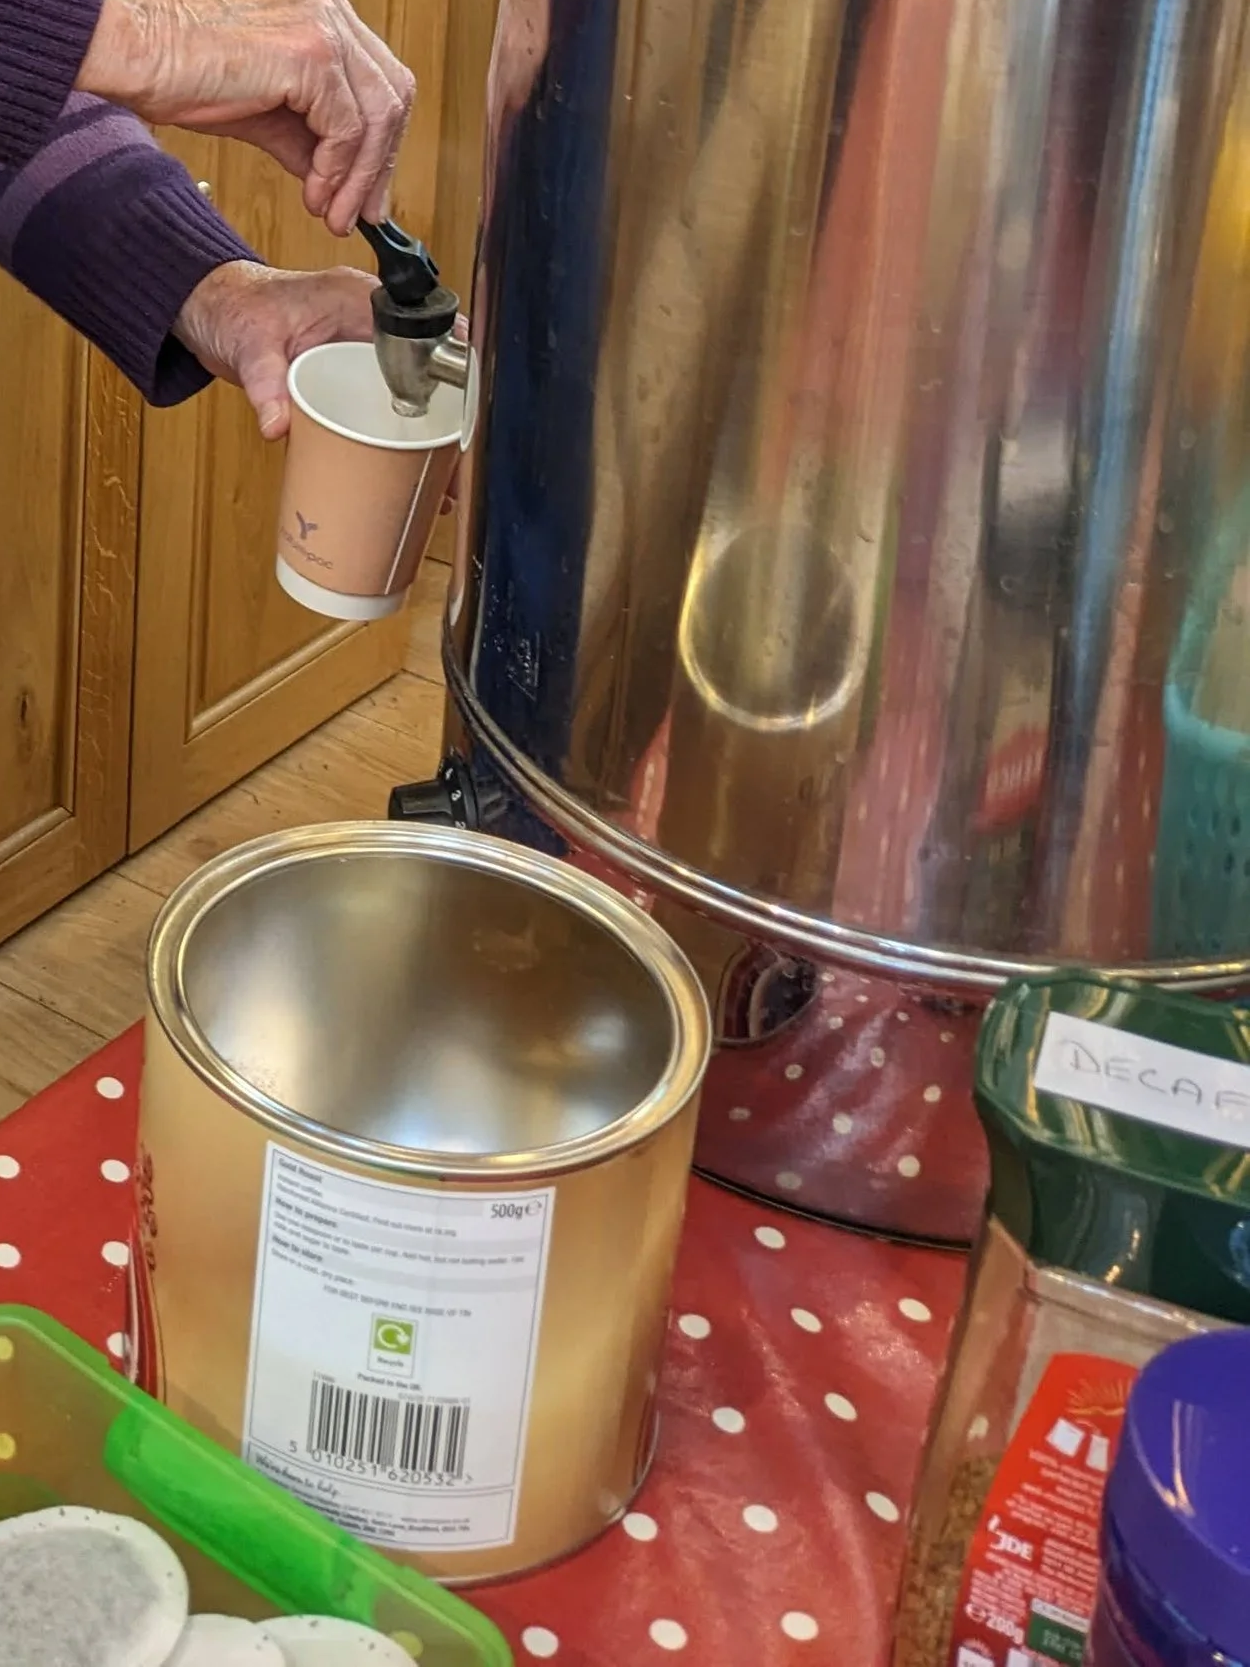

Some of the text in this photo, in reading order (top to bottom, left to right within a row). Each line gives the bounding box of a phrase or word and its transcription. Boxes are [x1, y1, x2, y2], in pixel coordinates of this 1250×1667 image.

[490, 1202, 524, 1221] 500g
[289, 1440, 298, 1453] 5
[388, 1469, 455, 1487] 620532
[991, 1531, 1034, 1562] JDE
